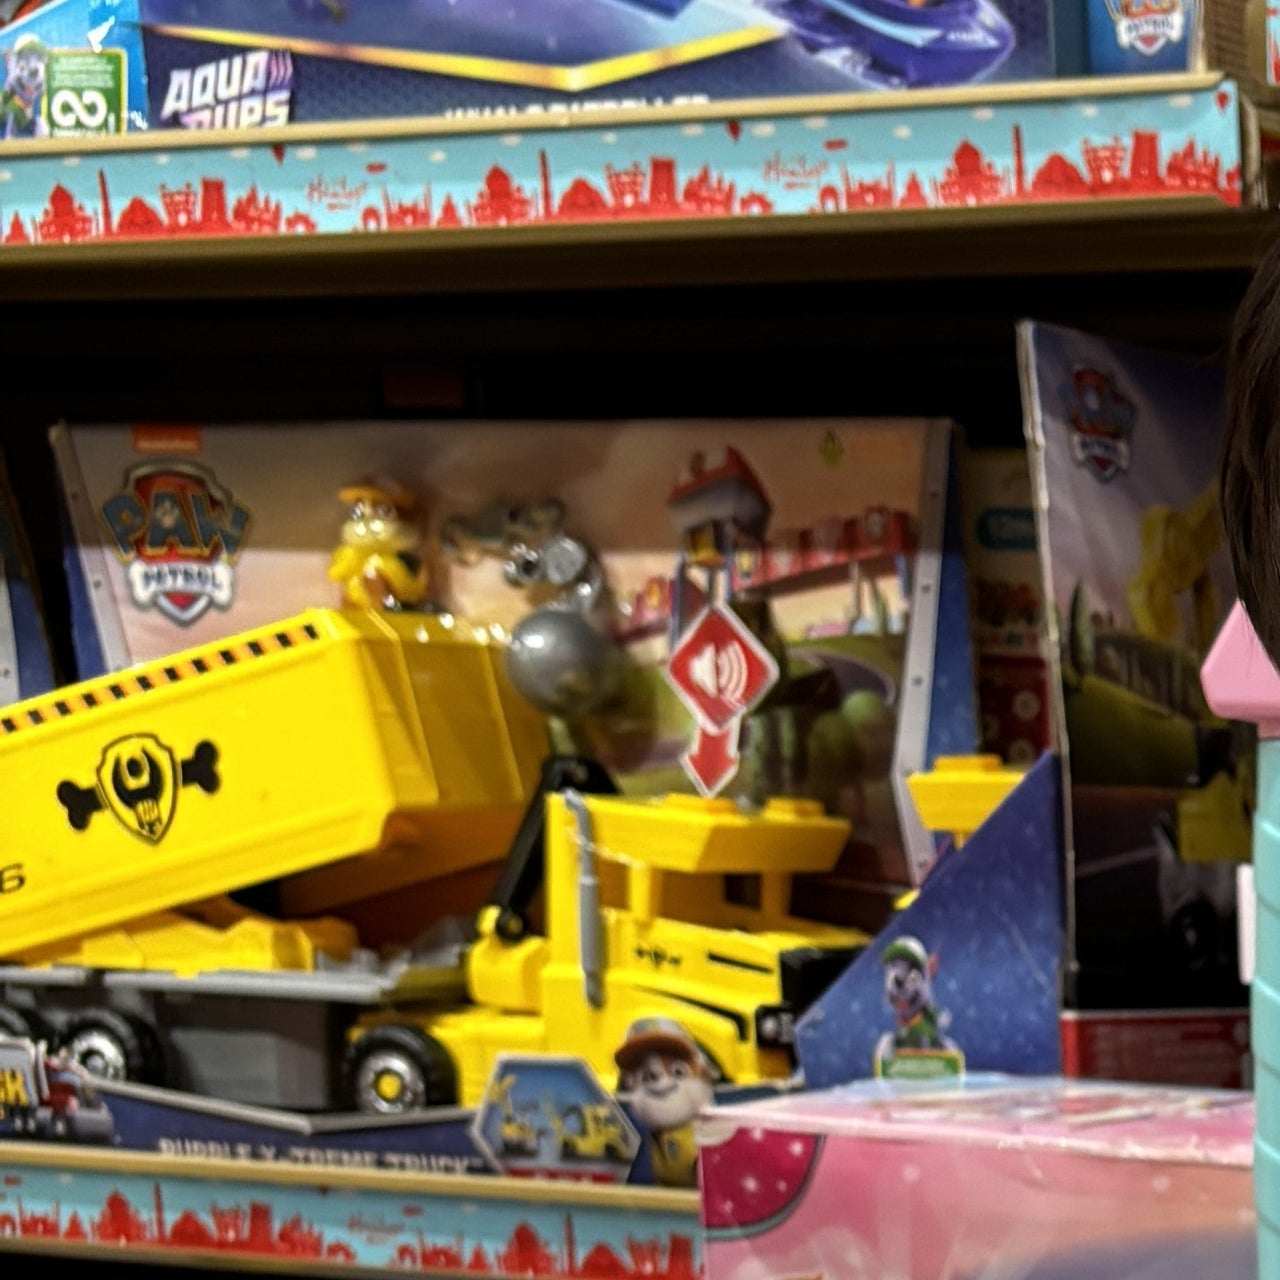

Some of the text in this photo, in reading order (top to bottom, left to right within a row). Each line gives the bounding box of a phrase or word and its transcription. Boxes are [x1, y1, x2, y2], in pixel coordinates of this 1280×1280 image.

[161, 50, 271, 119] AQUA
[102, 491, 251, 564] PAW
[142, 566, 219, 591] PATROL
